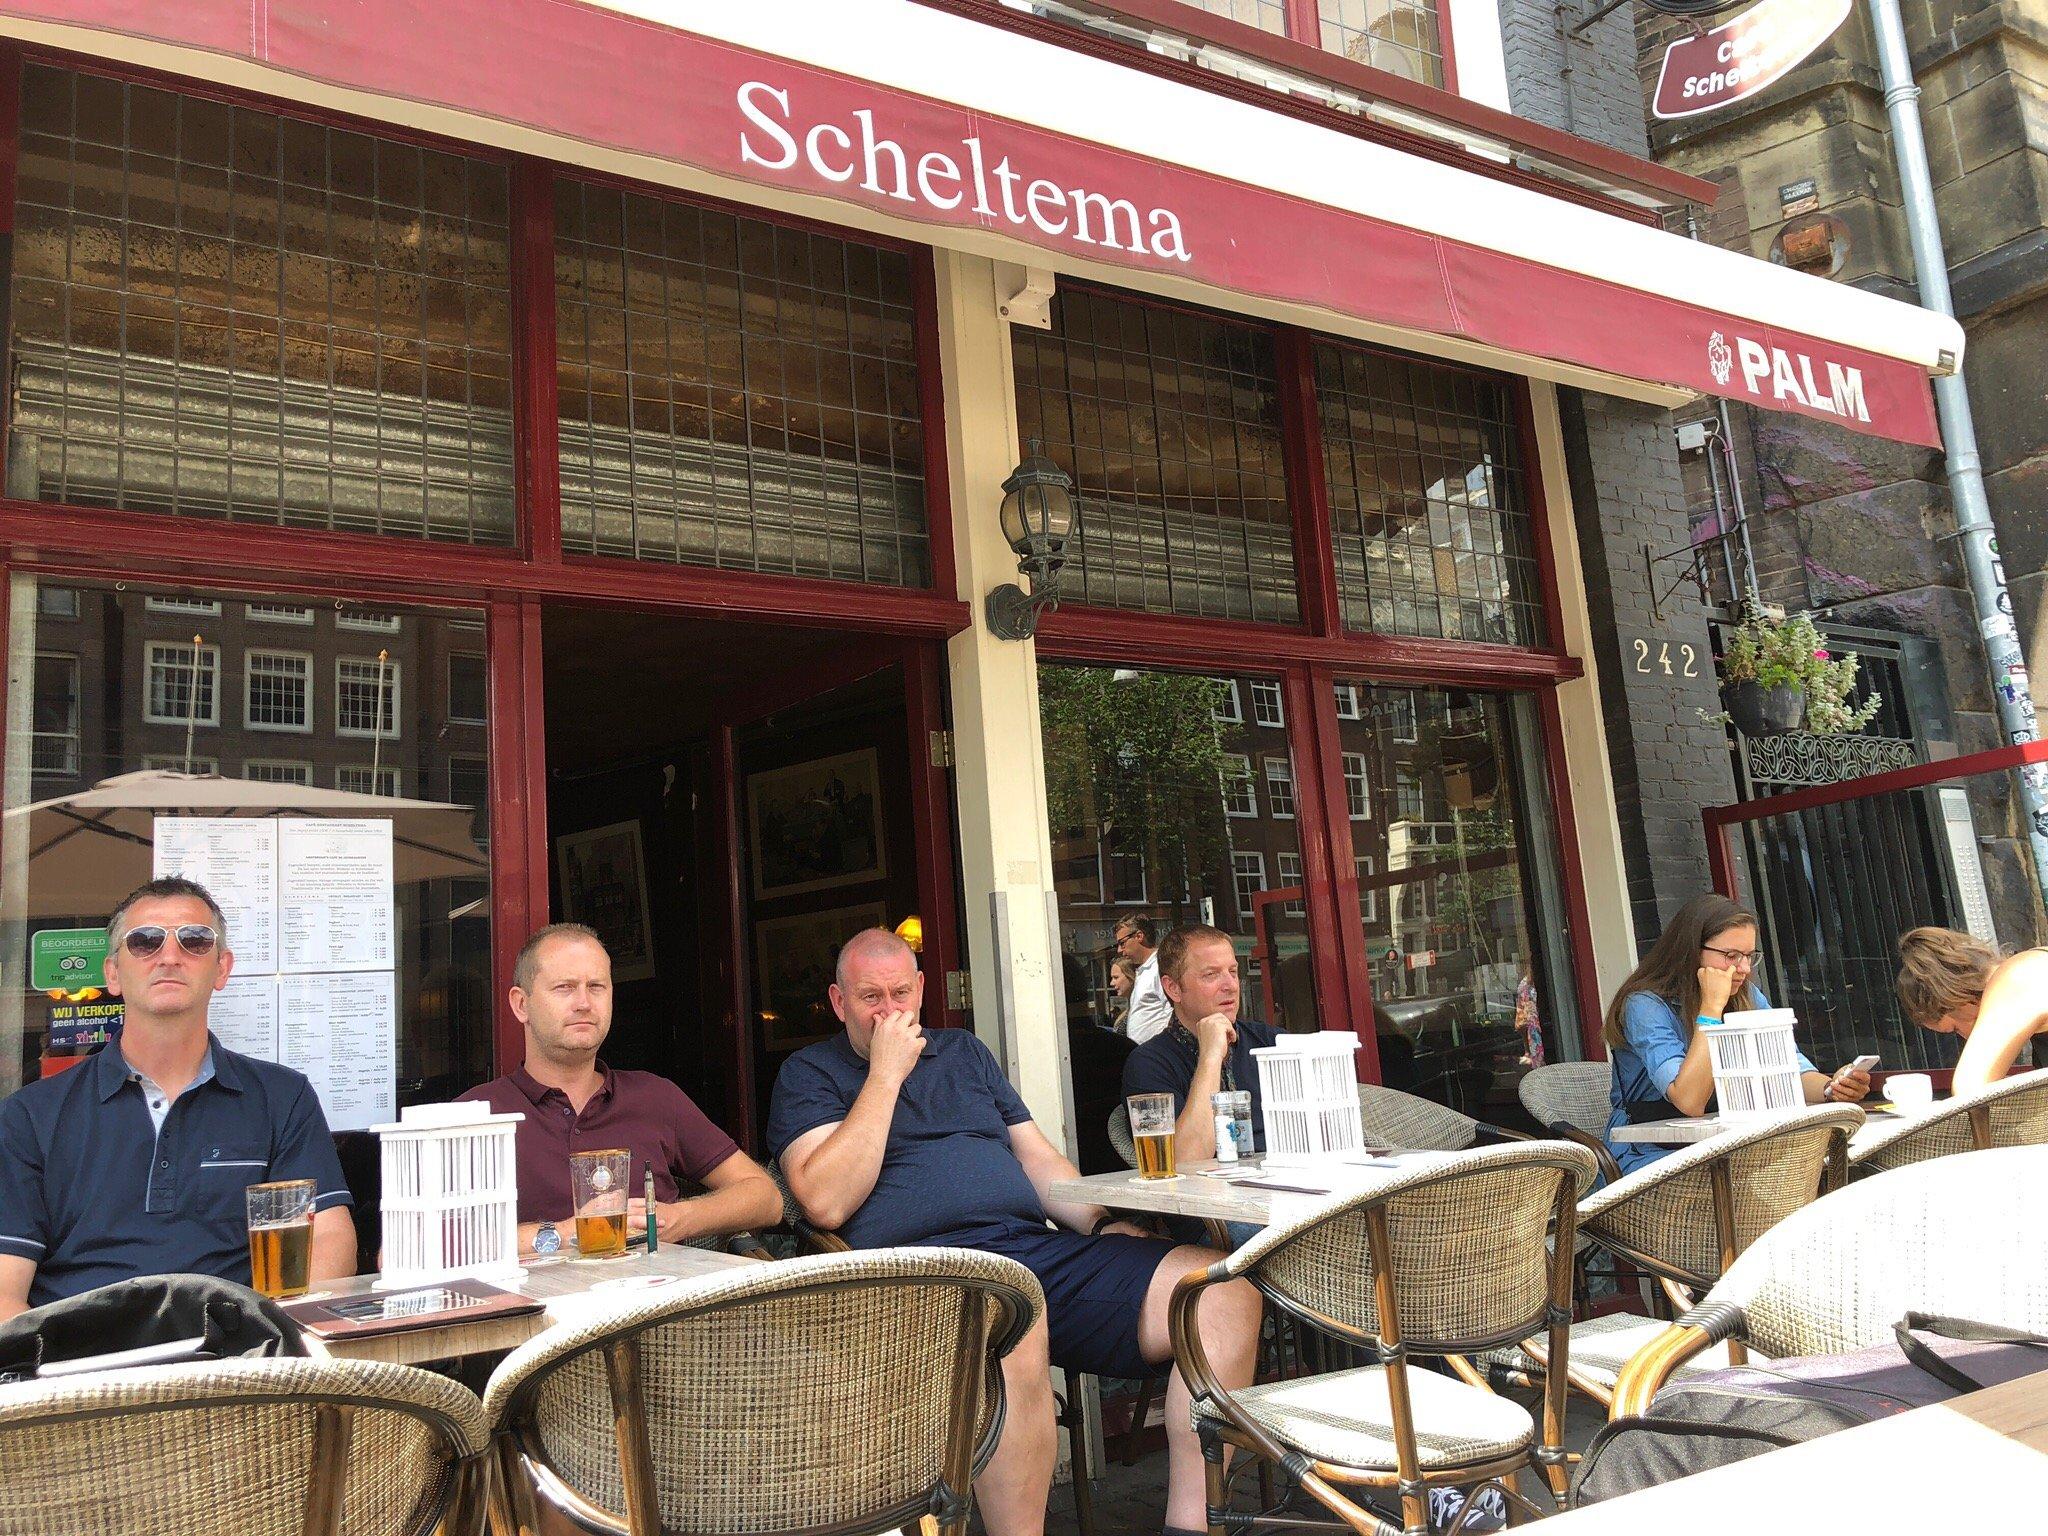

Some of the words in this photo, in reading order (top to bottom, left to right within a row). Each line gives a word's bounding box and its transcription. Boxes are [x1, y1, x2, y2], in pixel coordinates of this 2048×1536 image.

[736, 80, 1191, 263] Scheltema
[1735, 335, 1872, 424] PALM
[1634, 638, 1699, 678] 242
[41, 938, 106, 948] BEOORDEELD
[51, 972, 95, 982] tripadvisor
[52, 1007, 72, 1018] WIJ
[76, 1004, 125, 1018] VERKOPE
[52, 1018, 75, 1028] geen
[77, 1016, 108, 1026] alcohol
[110, 1015, 123, 1025] <1
